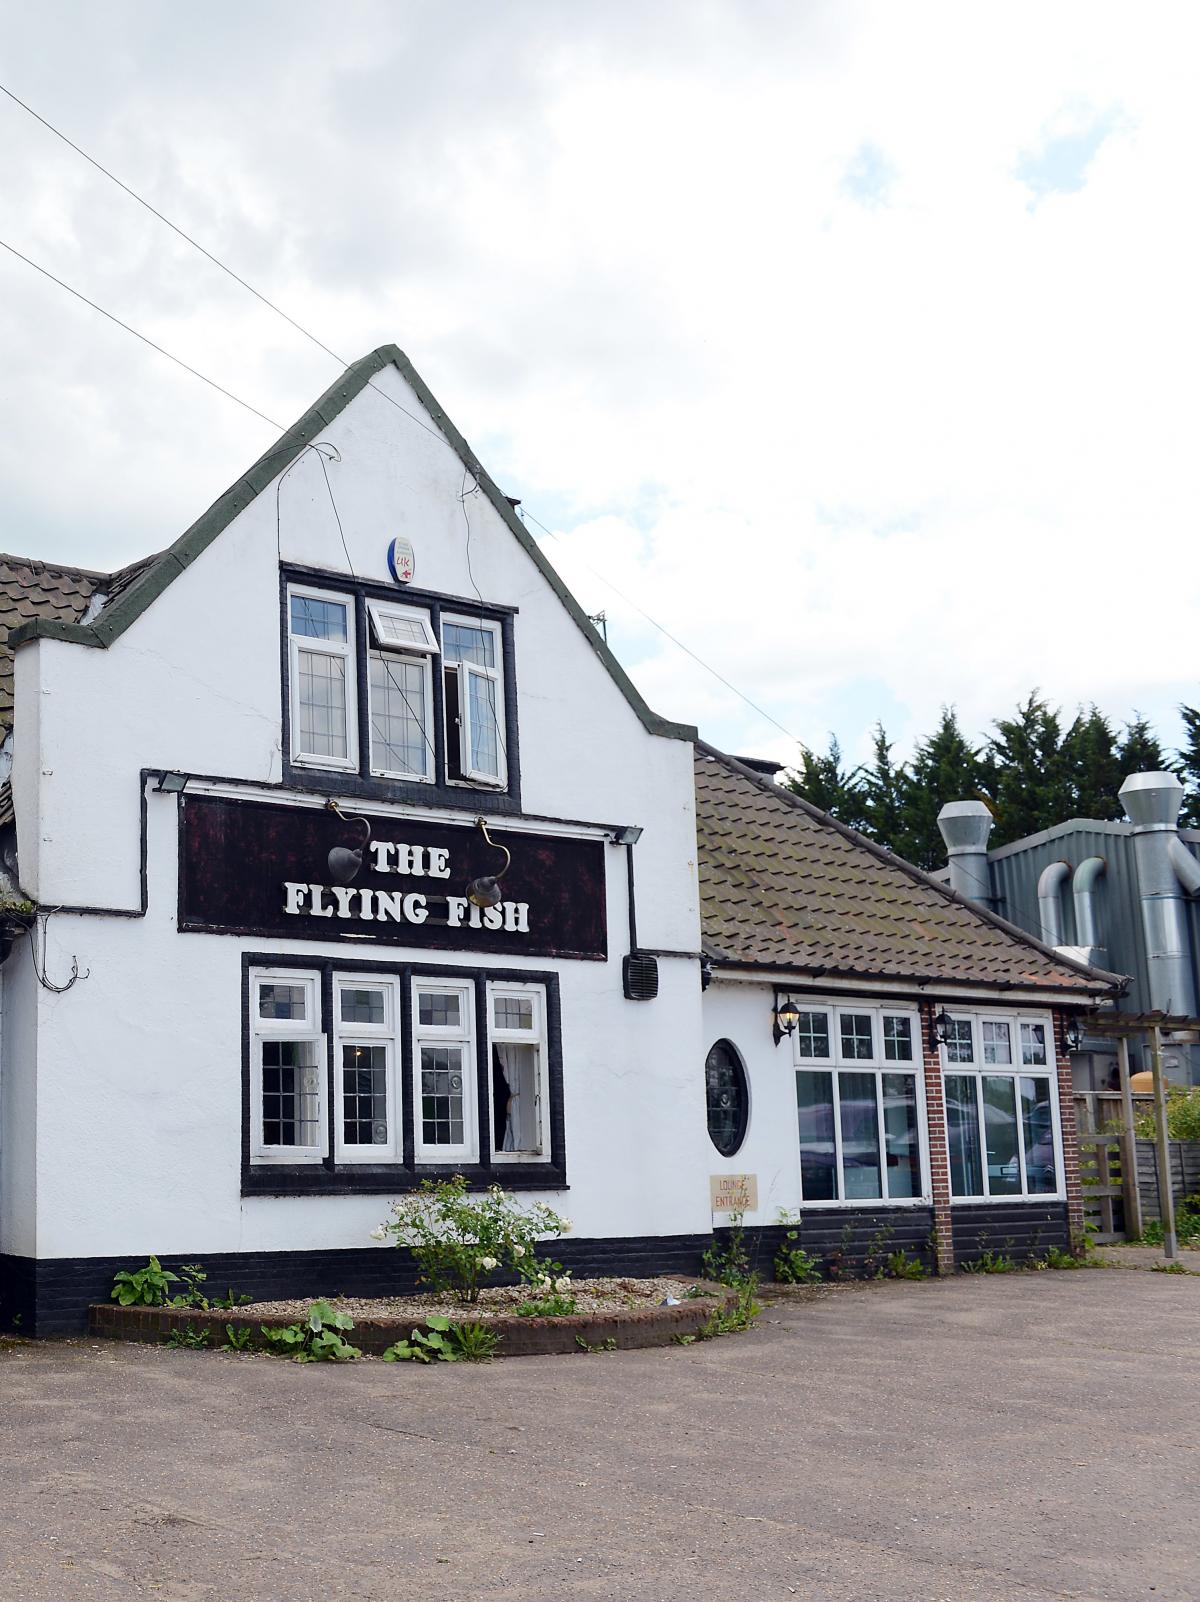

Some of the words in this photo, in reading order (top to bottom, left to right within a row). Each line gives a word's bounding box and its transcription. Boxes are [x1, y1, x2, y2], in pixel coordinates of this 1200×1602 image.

[370, 841, 451, 879] THE
[284, 882, 429, 924] FLYING
[446, 896, 530, 932] FISH
